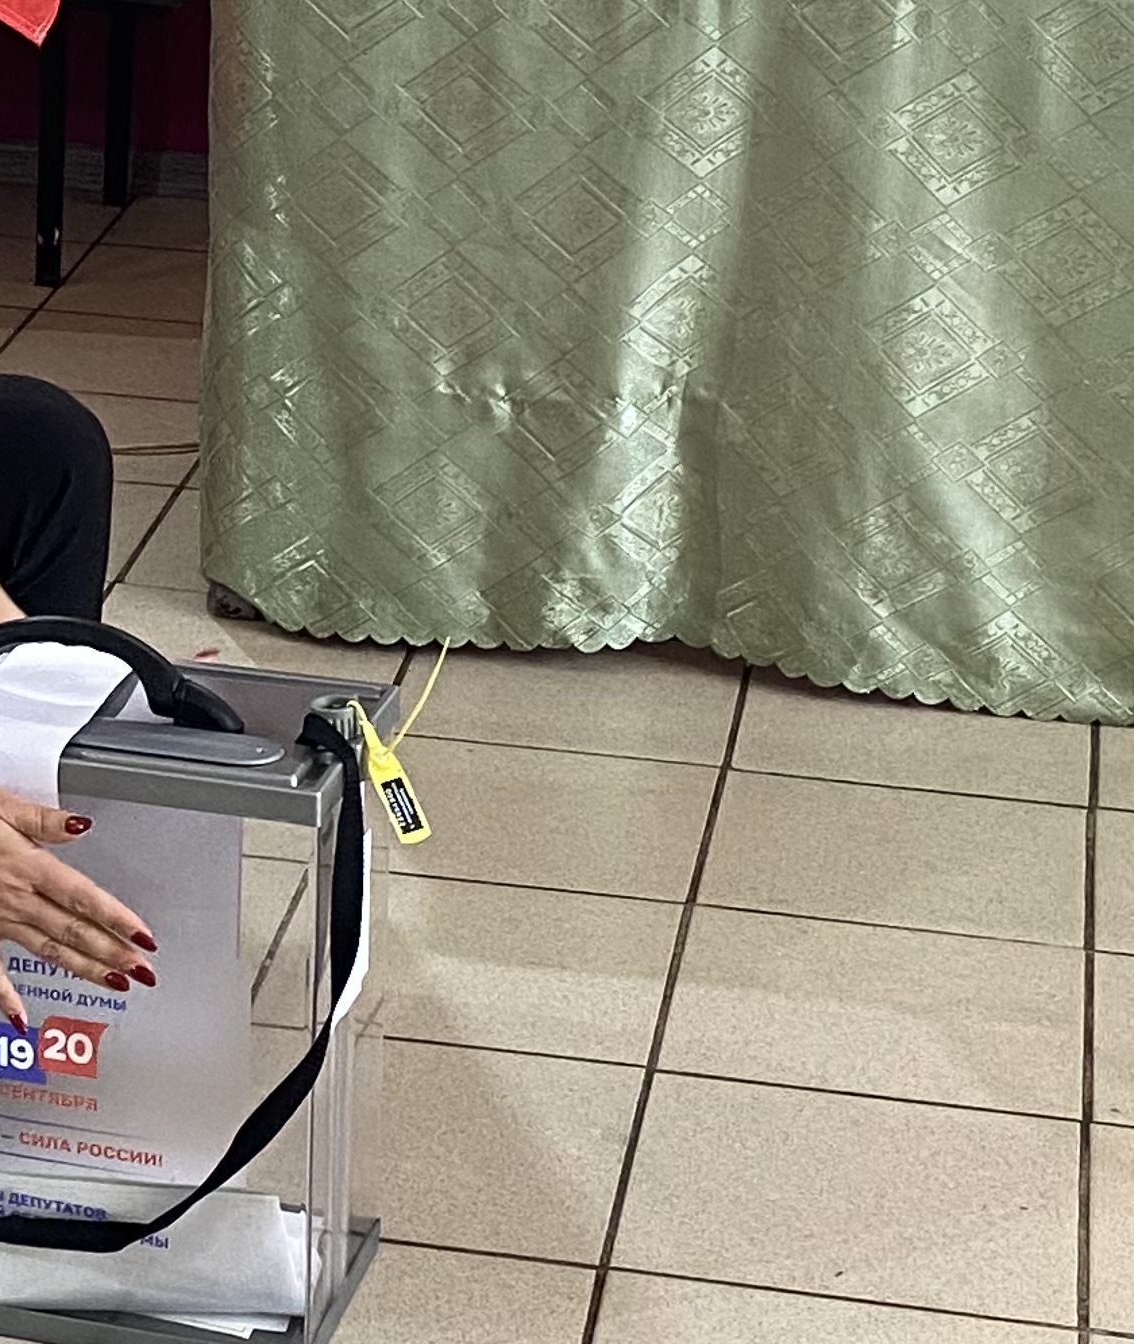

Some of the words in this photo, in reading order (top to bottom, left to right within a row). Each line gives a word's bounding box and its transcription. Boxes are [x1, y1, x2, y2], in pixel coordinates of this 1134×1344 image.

[76, 993, 127, 1011] ДУМЫ
[43, 1028, 94, 1065] 20
[18, 1130, 71, 1153] СИЛА
[77, 1141, 163, 1167] РОССИИ!
[8, 1191, 107, 1221] ДЕПУТАТОВ
